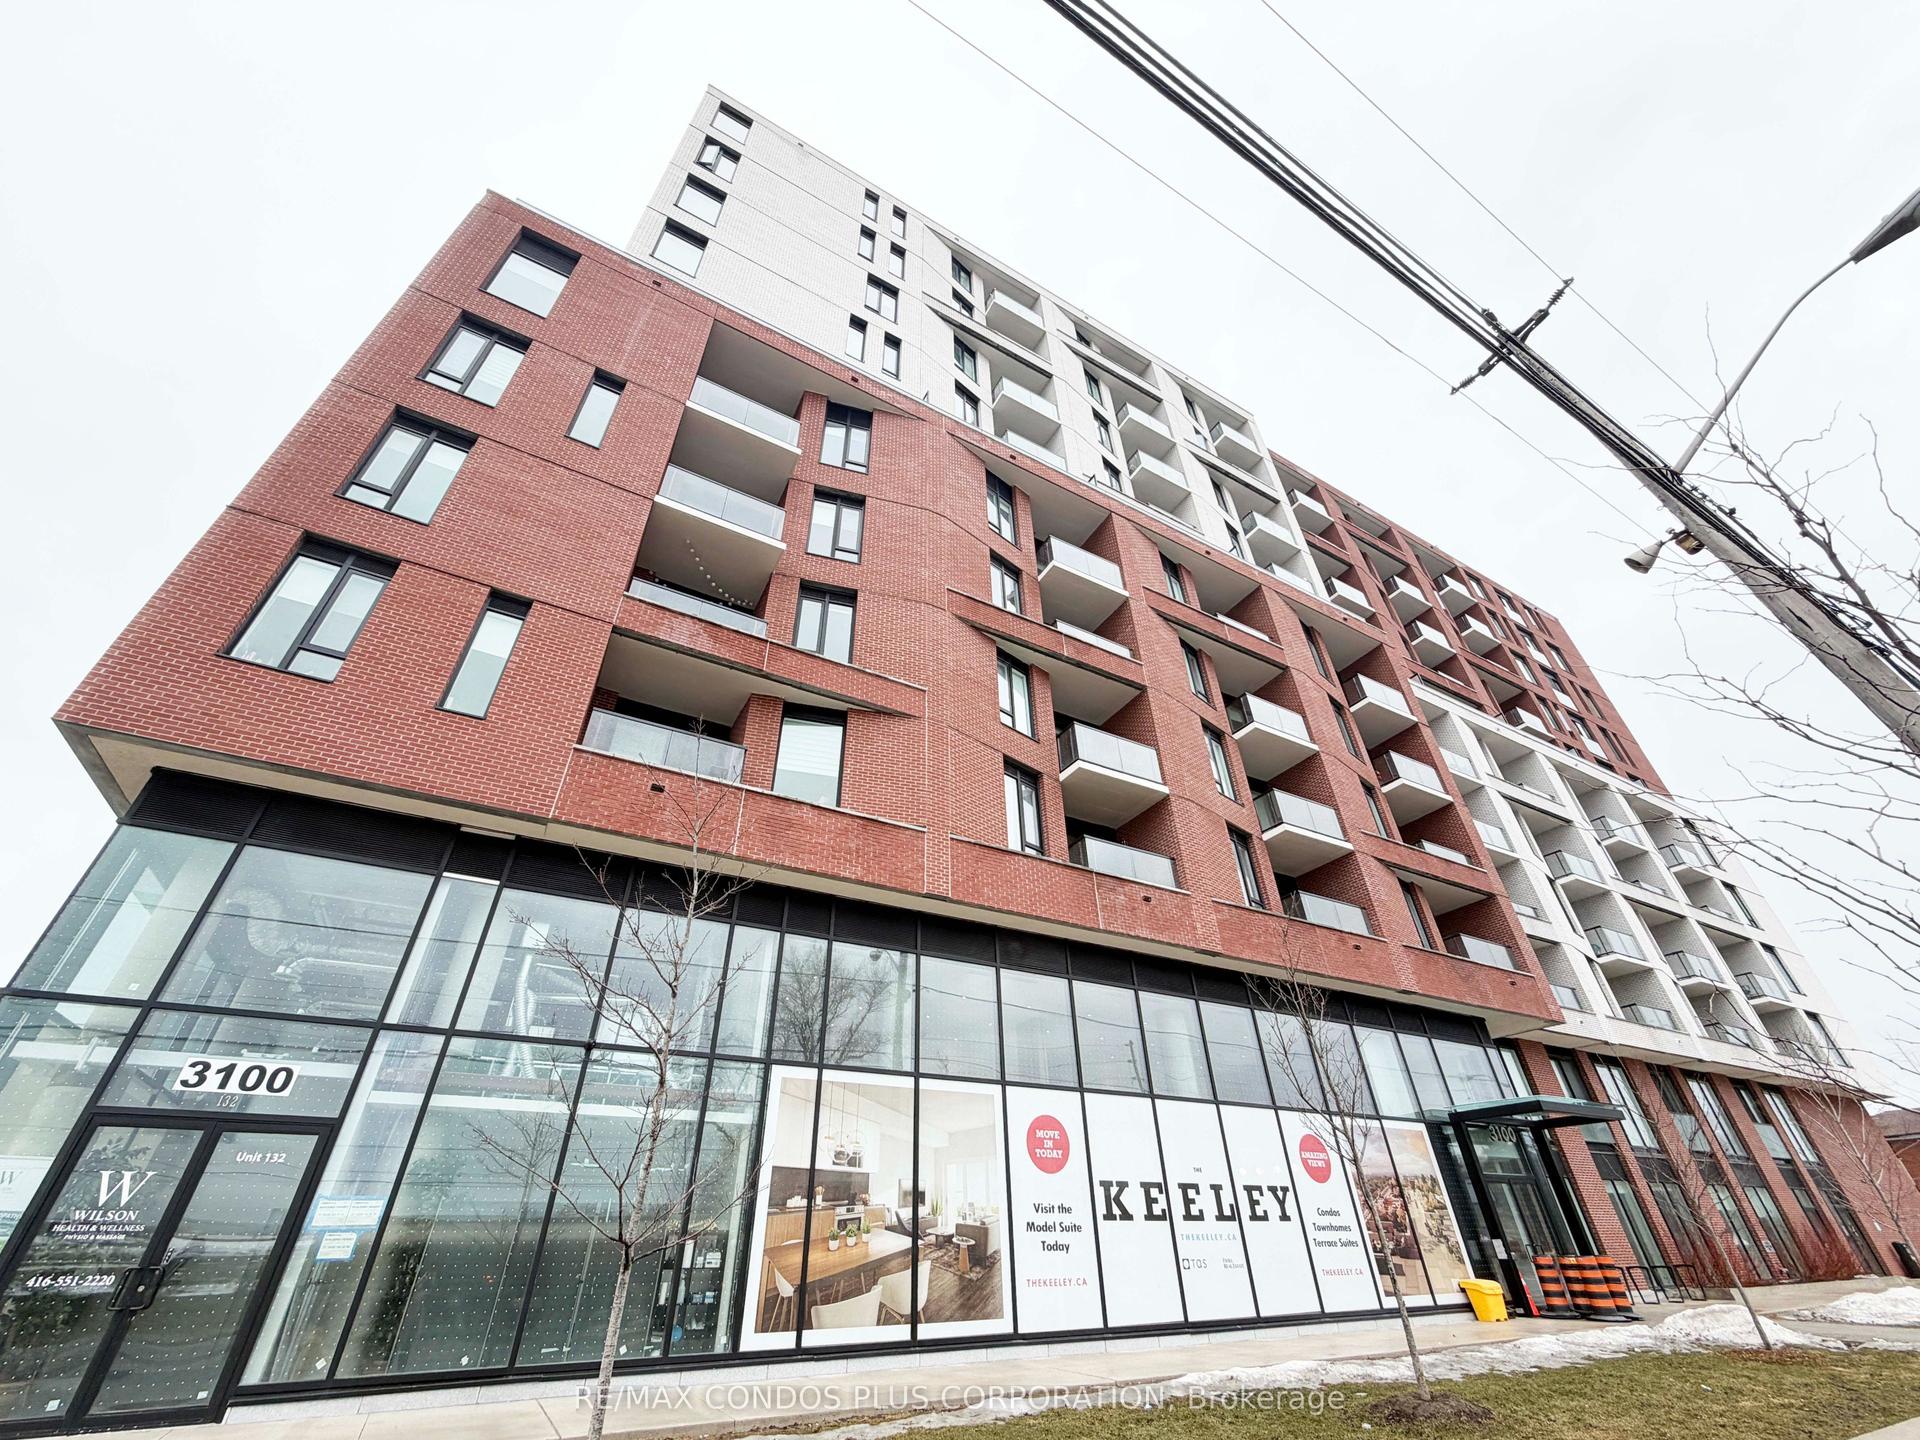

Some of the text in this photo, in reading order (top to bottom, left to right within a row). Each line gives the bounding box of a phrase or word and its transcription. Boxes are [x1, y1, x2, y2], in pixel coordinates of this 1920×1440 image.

[180, 1060, 294, 1093] 3100
[216, 1094, 239, 1108] 132
[1035, 1130, 1060, 1139] MOVE
[1488, 1124, 1517, 1143] 3100
[1043, 1140, 1053, 1148] IN
[236, 1152, 286, 1163] Unit 132
[1035, 1149, 1063, 1158] TODAY
[1300, 1151, 1328, 1160] AMAZING
[1307, 1159, 1326, 1168] VIEWS
[98, 1170, 158, 1208] W
[1099, 1180, 1292, 1222] KEELEY
[1033, 1203, 1072, 1214] Visit the
[1317, 1208, 1341, 1217] Condos
[74, 1210, 140, 1221] WILSON
[52, 1224, 146, 1232] HEALTH & WELLNESS
[1026, 1221, 1082, 1232] Model Suite
[1312, 1223, 1352, 1232] Townhomes
[1041, 1240, 1070, 1254] Today
[1313, 1238, 1359, 1248] Terrace Suites
[26, 1275, 116, 1287] 416-551-2220
[1026, 1278, 1088, 1287] THEKEELEY.CA
